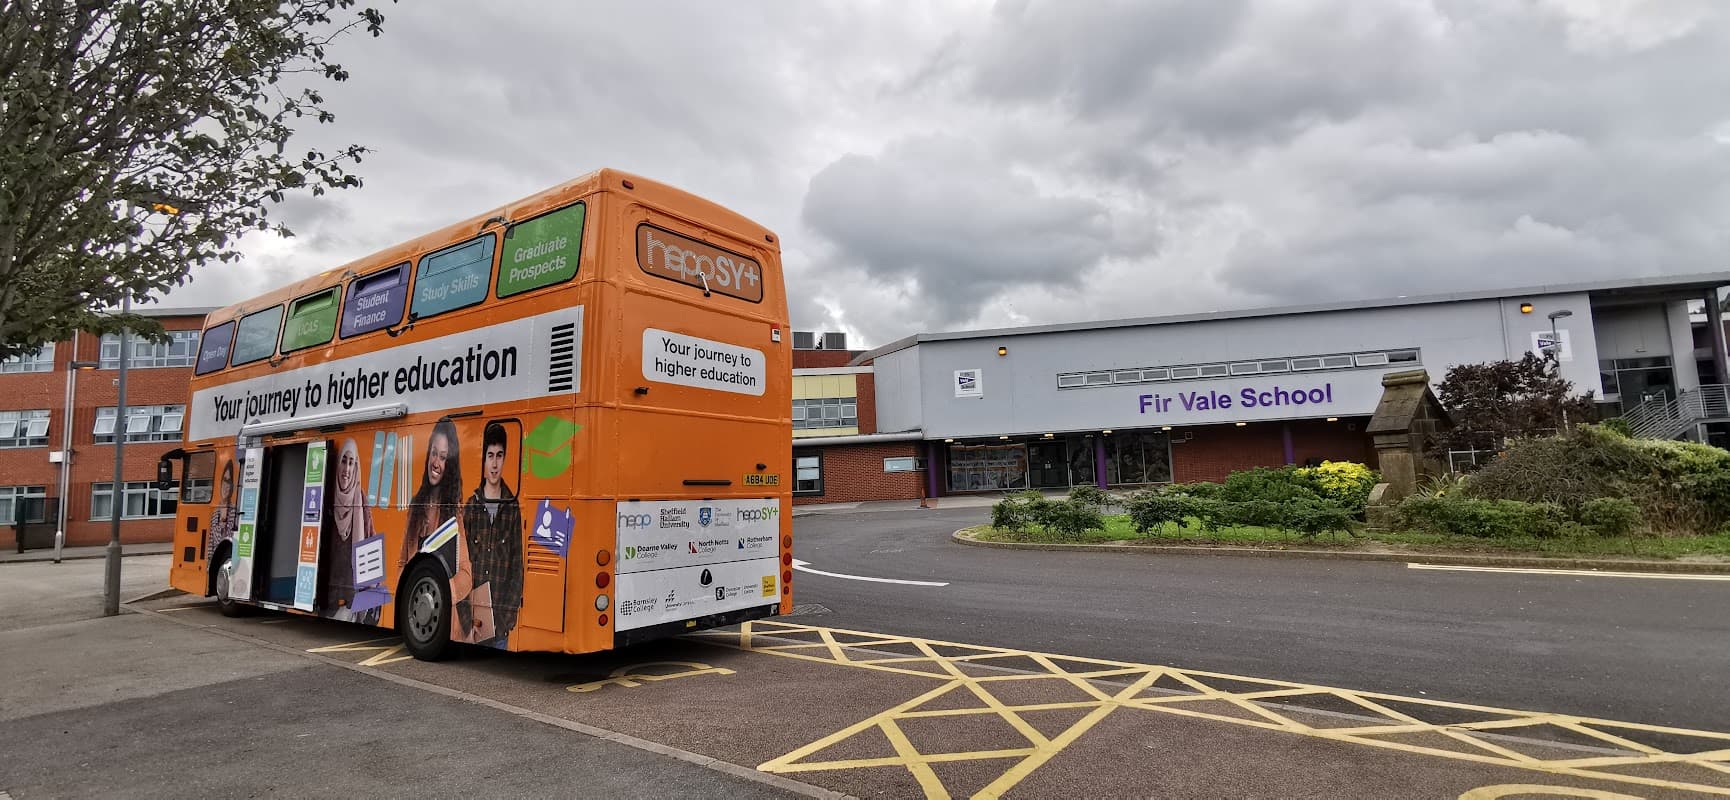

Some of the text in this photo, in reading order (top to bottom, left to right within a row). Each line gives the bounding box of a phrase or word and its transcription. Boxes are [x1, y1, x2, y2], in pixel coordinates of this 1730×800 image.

[514, 236, 568, 263] Graduate
[509, 255, 567, 283] Prospects
[356, 290, 390, 311] Student
[421, 274, 479, 303] Study Skills
[354, 310, 387, 329] Finance
[662, 337, 751, 367] Your journey to
[214, 344, 517, 424] Your journey to higher education
[655, 357, 756, 387] higher education
[1139, 383, 1333, 413] Fir Vale School
[660, 520, 690, 529] University
[633, 597, 658, 605] Barnsley
[633, 604, 654, 613] College
